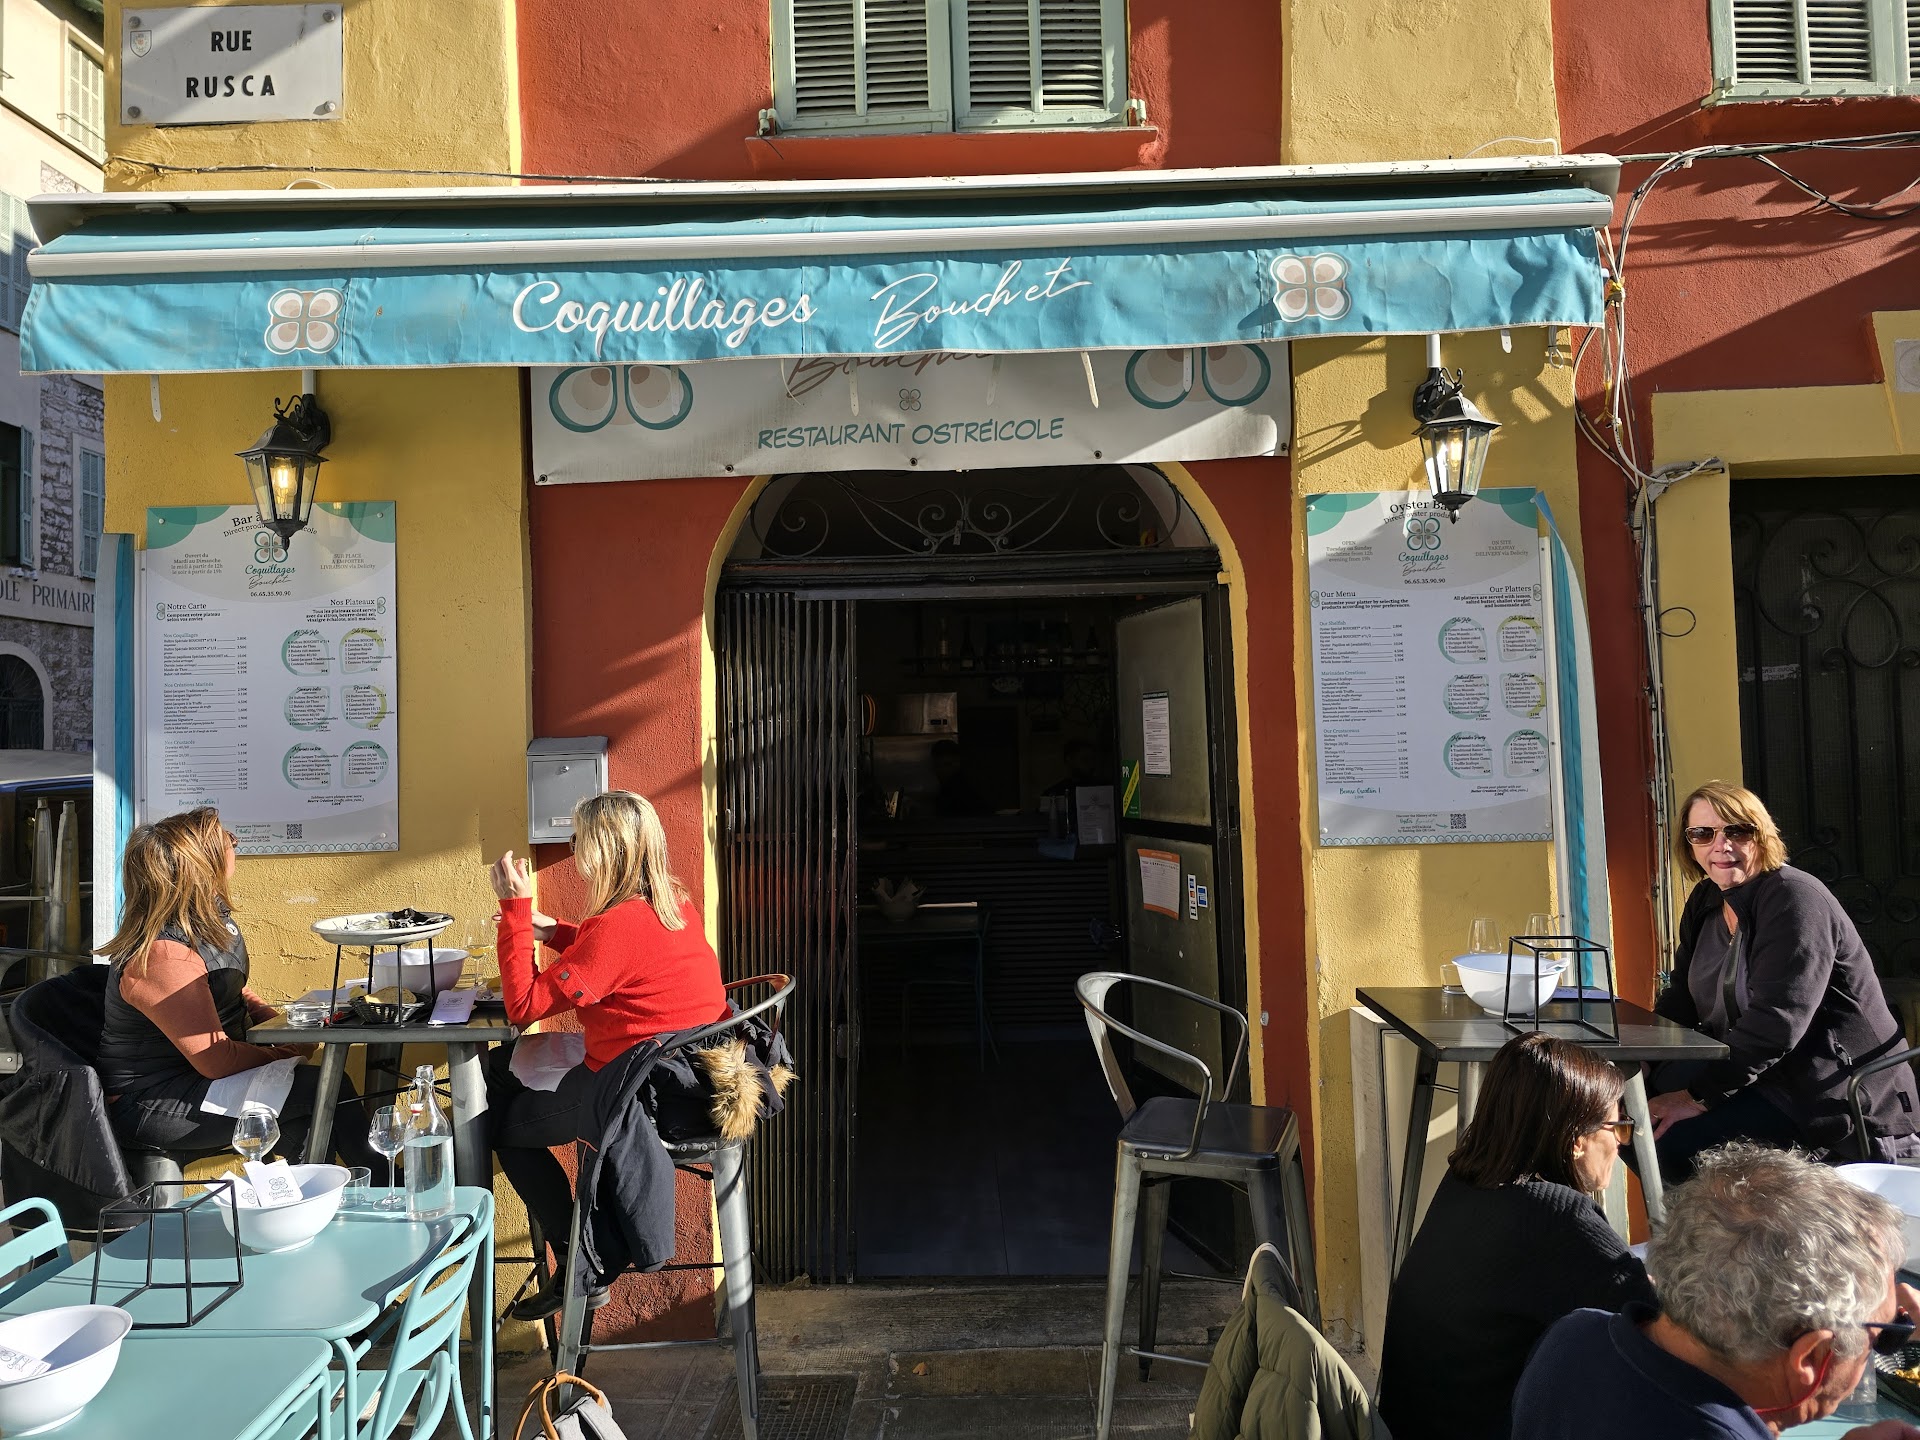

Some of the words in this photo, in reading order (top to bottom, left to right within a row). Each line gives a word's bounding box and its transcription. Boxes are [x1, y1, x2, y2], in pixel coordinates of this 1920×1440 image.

[211, 30, 252, 52] RUE
[186, 75, 275, 98] RUSCA
[512, 279, 817, 358] Coquillages
[869, 256, 1093, 349] Bouchet
[757, 423, 905, 450] RESTAURANT
[911, 416, 1064, 445] OSTRÉICOLE
[1390, 500, 1429, 515] Oyster
[1433, 500, 1447, 510] Ba
[232, 515, 253, 527] Bar
[1383, 514, 1406, 524] Direct
[223, 526, 245, 537] Direct
[1398, 551, 1449, 564] Coquillages
[245, 564, 296, 578] Coquillages
[1402, 562, 1446, 577] Bouchet
[248, 574, 292, 590] Bouchet
